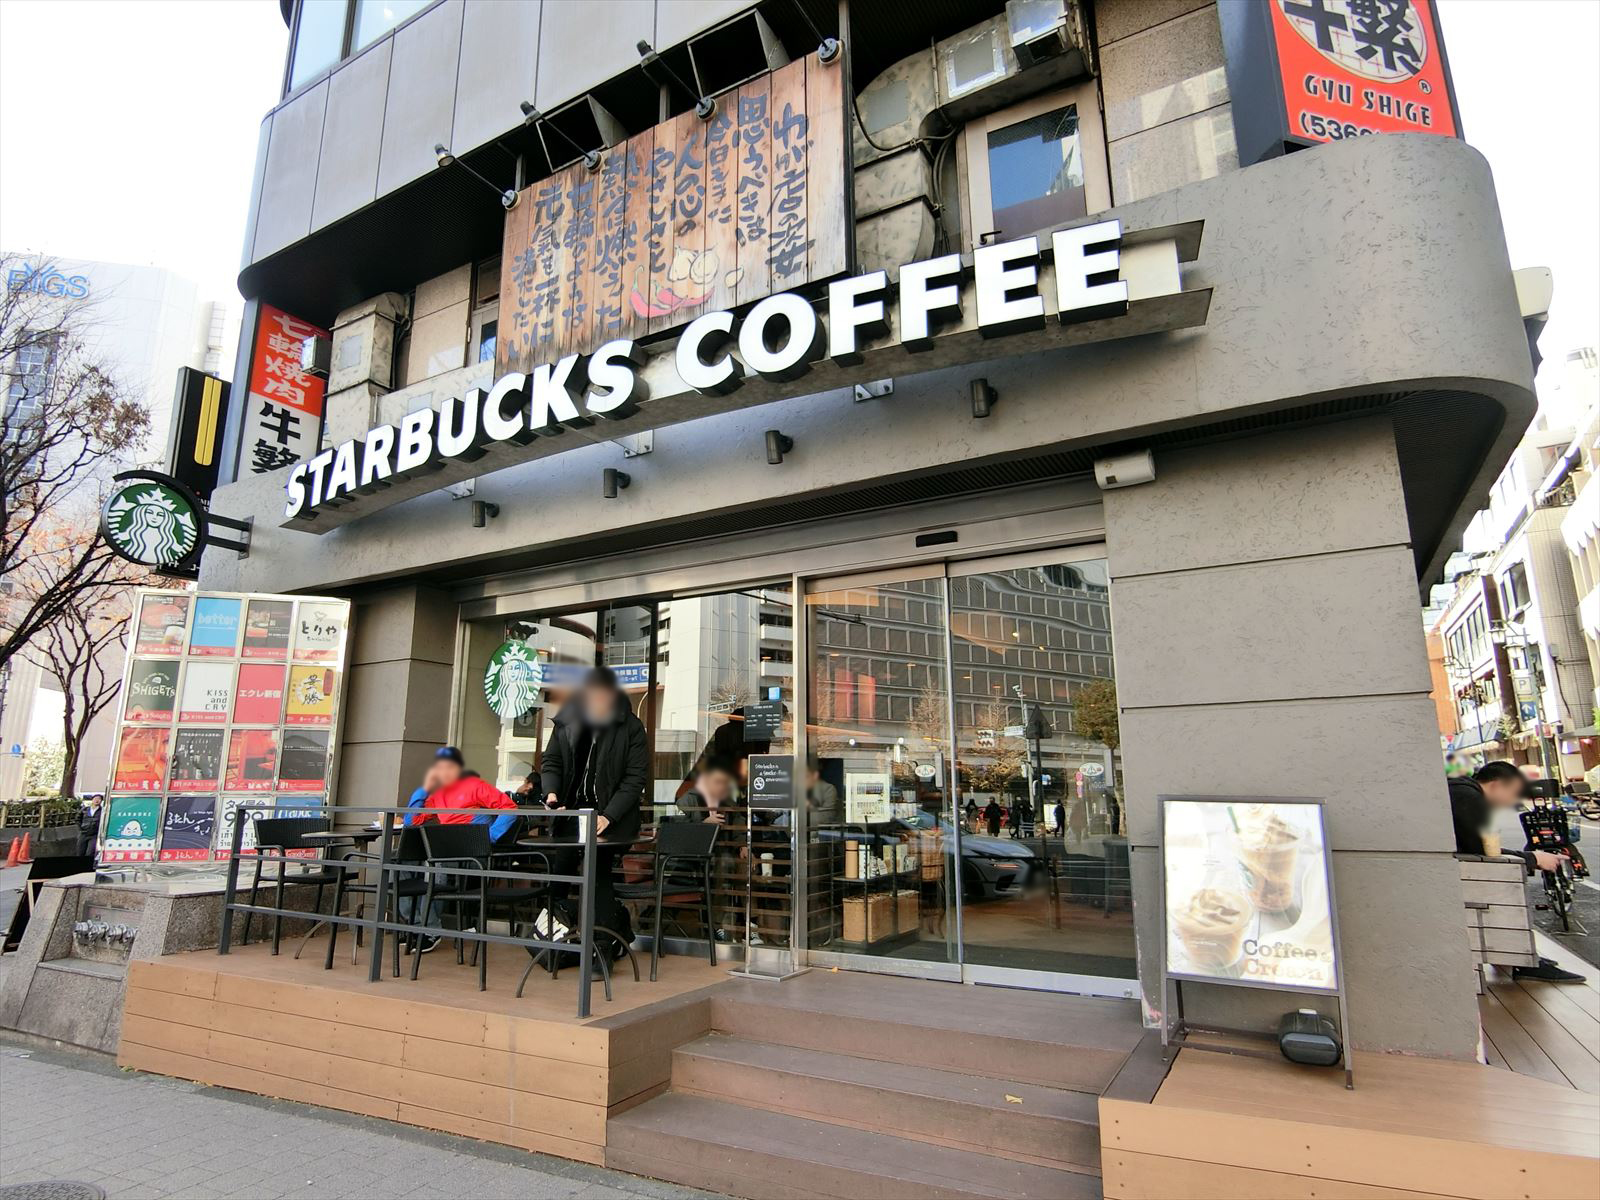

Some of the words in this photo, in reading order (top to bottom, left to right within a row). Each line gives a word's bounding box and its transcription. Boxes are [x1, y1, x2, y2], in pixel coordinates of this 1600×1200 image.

[1304, 75, 1351, 105] GYU
[1363, 90, 1432, 126] SHIGE
[675, 218, 1129, 389] COFFEE
[285, 340, 635, 519] STARBUCKS
[302, 620, 337, 635] とりや
[206, 689, 229, 697] KISS
[1519, 680, 1527, 690] P
[1243, 939, 1317, 960] Coffee
